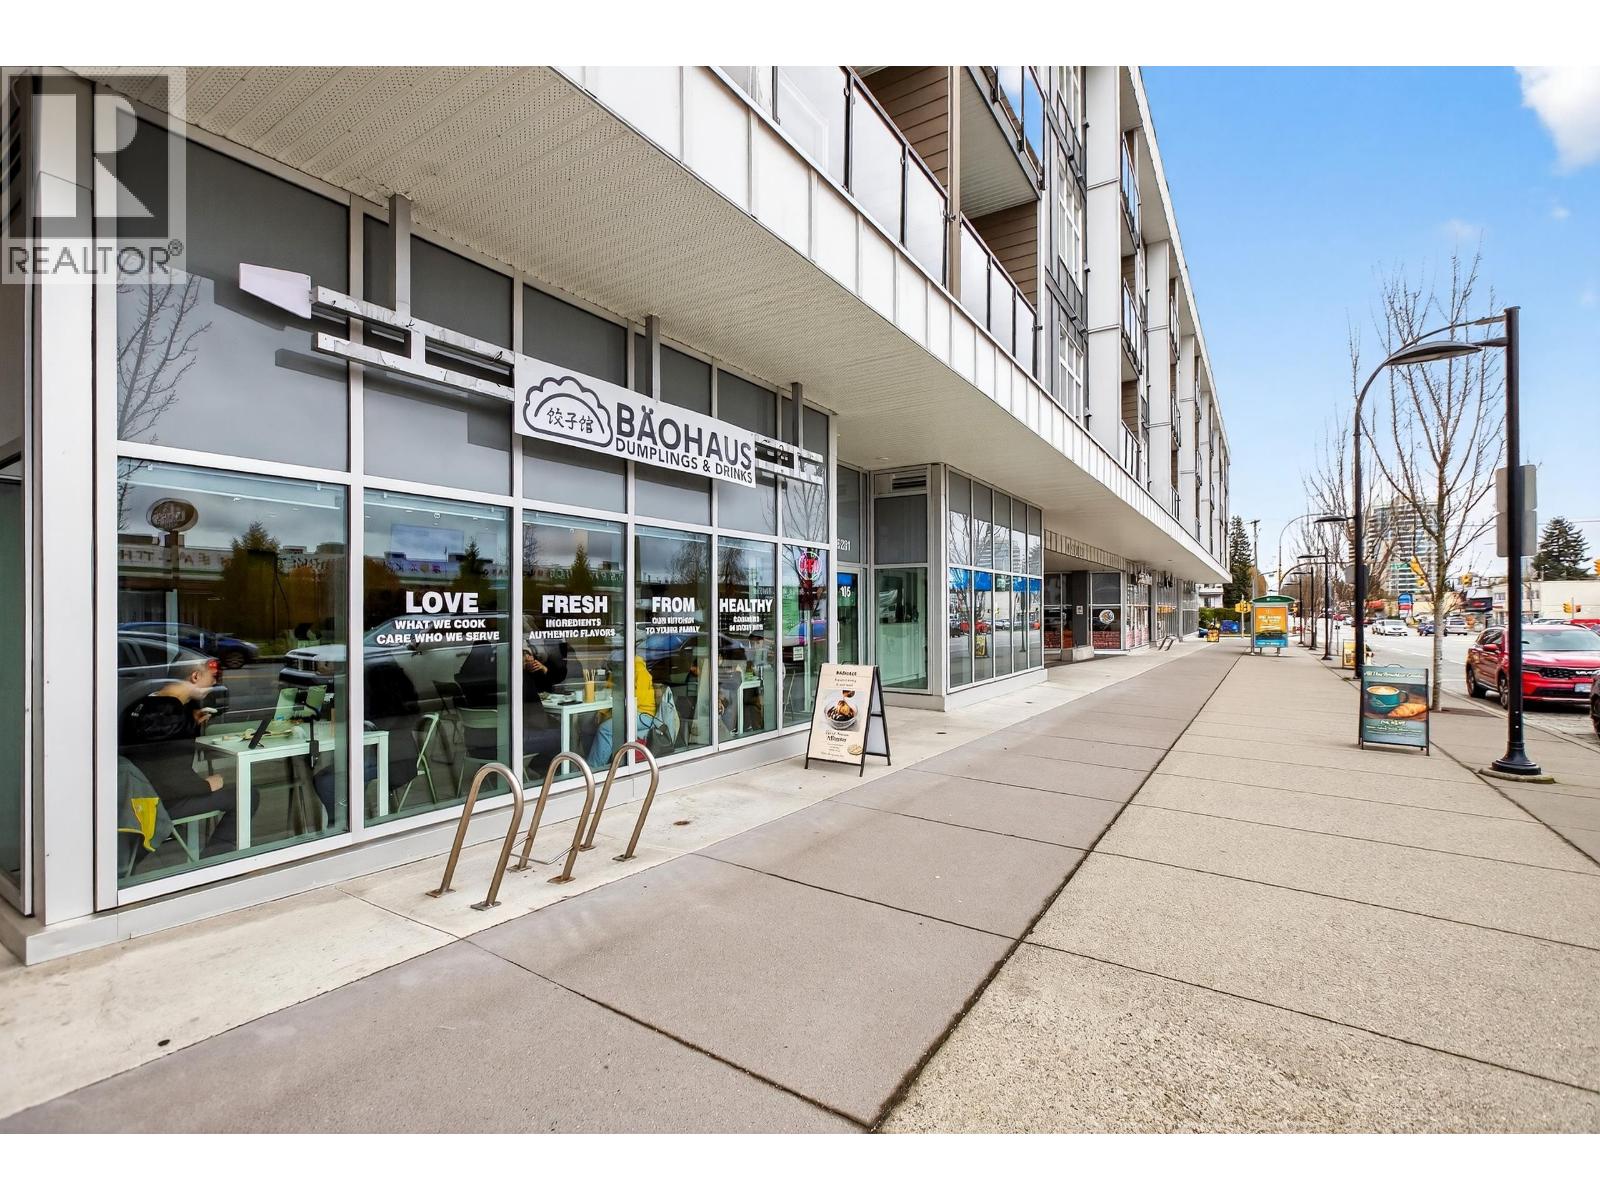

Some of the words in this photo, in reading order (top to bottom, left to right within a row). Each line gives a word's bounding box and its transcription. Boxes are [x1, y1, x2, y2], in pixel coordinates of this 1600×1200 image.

[547, 407, 594, 434] 饺子馆
[616, 438, 698, 470] DUMPLINGS
[703, 460, 711, 473] &
[715, 463, 753, 484] DRINKS
[405, 591, 479, 614] LOVE
[542, 595, 608, 613] FRESH
[652, 597, 695, 612] FROM
[720, 598, 773, 613] HEALTHY
[395, 620, 430, 630] WHAT
[433, 619, 451, 629] WE
[454, 619, 486, 629] COOK
[545, 618, 602, 628] INGREDIENTS
[376, 634, 411, 645] CARE
[415, 632, 442, 643] WHO
[446, 632, 462, 642] WE
[466, 631, 500, 640] SERVE
[529, 630, 578, 640] AUTHENTIC
[580, 628, 616, 638] FLAVORS
[645, 627, 655, 635] TO
